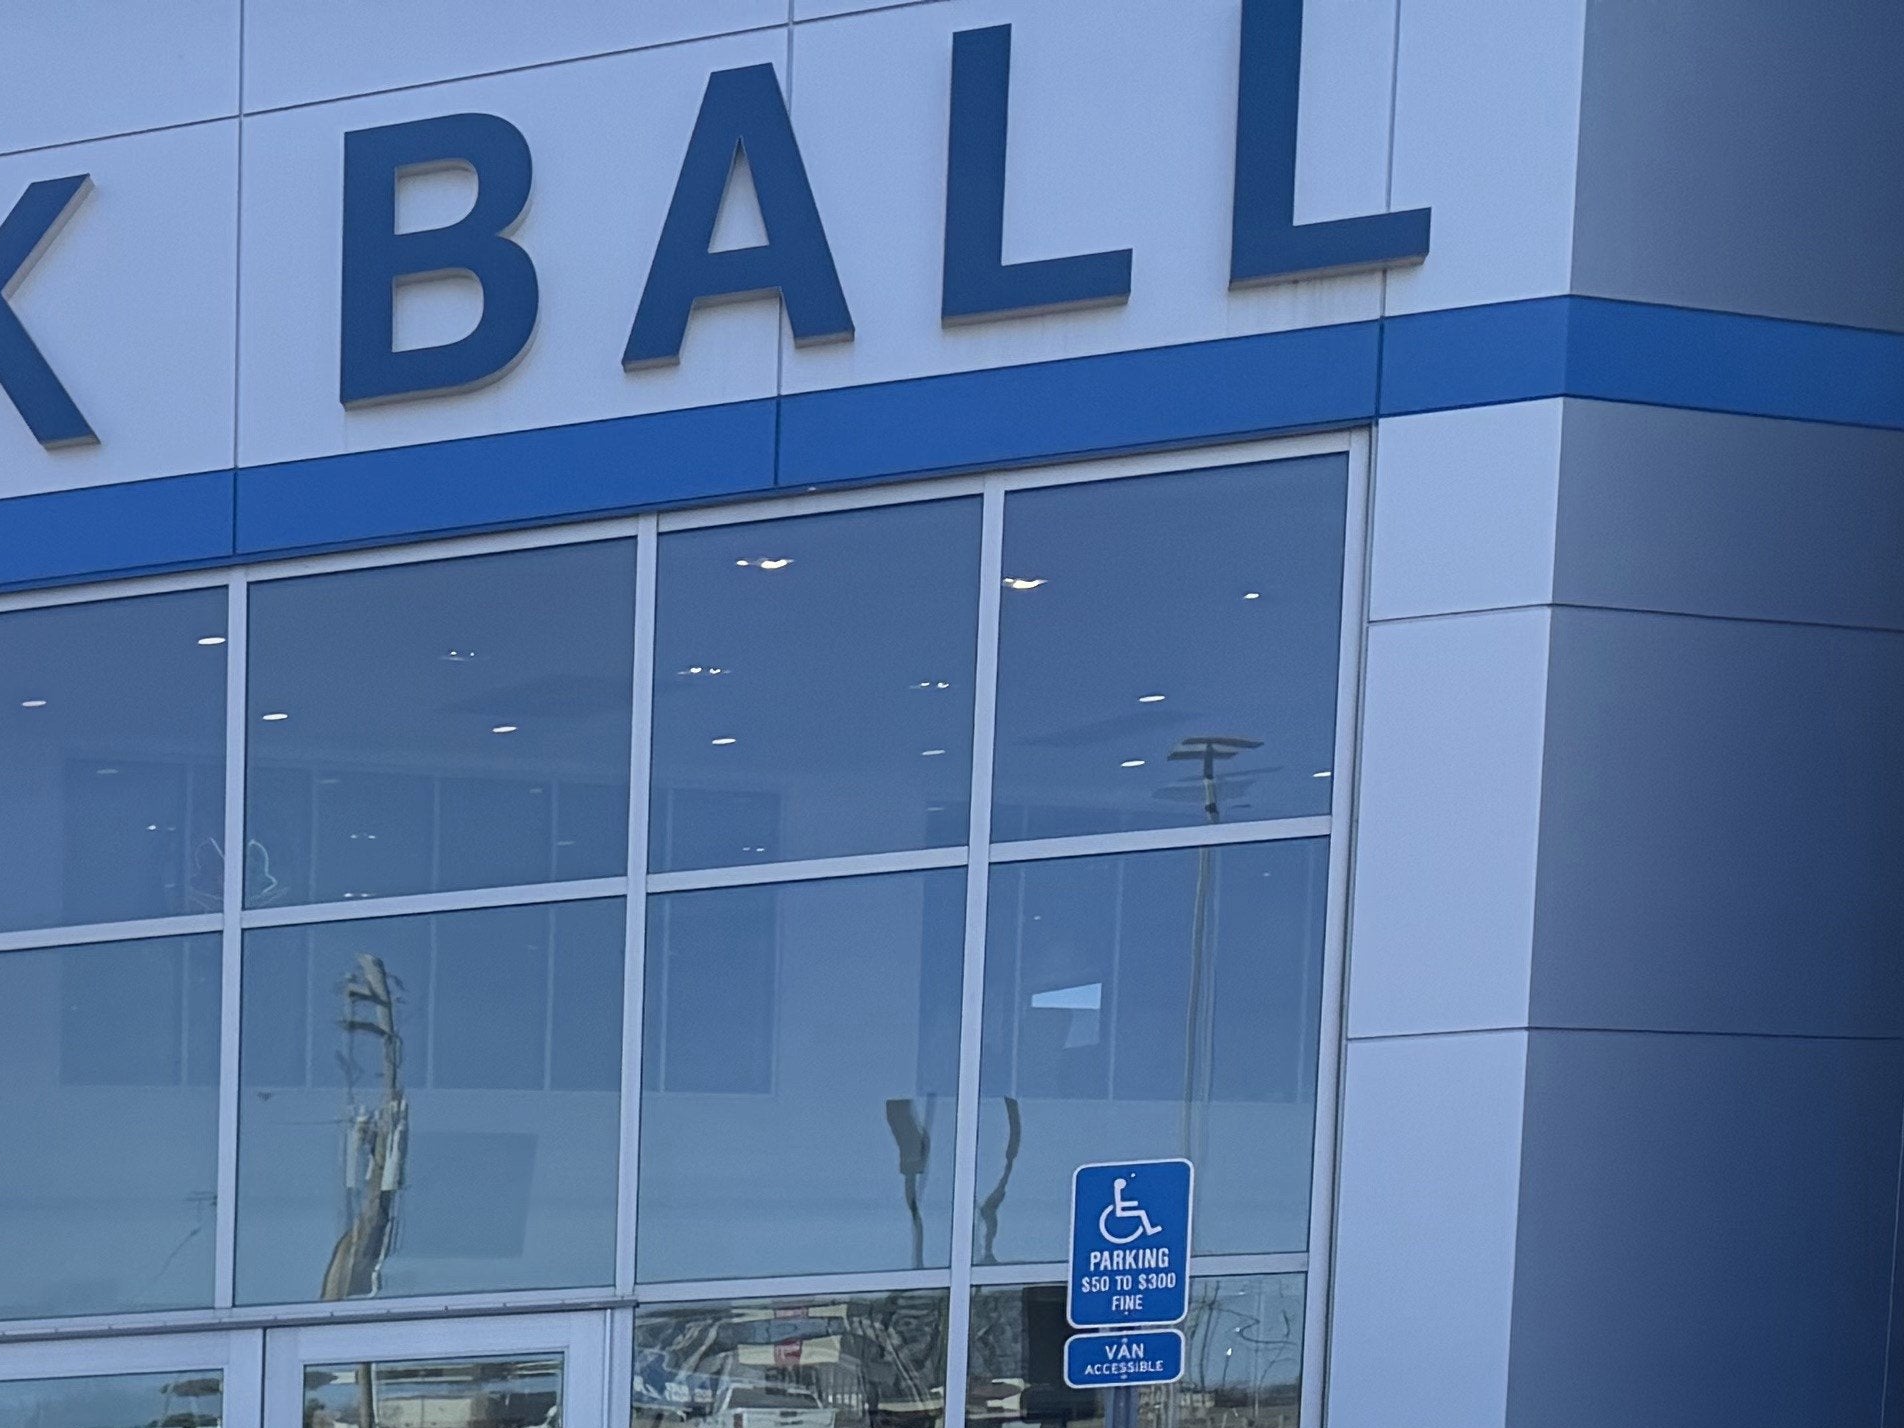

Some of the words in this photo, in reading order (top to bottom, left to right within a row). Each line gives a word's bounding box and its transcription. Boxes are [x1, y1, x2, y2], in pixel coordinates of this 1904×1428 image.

[338, 0, 1432, 408] BALL
[1090, 1248, 1169, 1271] PARKING
[1081, 1276, 1109, 1293] $50
[1115, 1275, 1132, 1291] TO
[1138, 1273, 1176, 1290] $300
[1111, 1296, 1143, 1311] FINE
[1105, 1343, 1144, 1360] VAN
[1085, 1361, 1164, 1376] ACCESSIBLE
